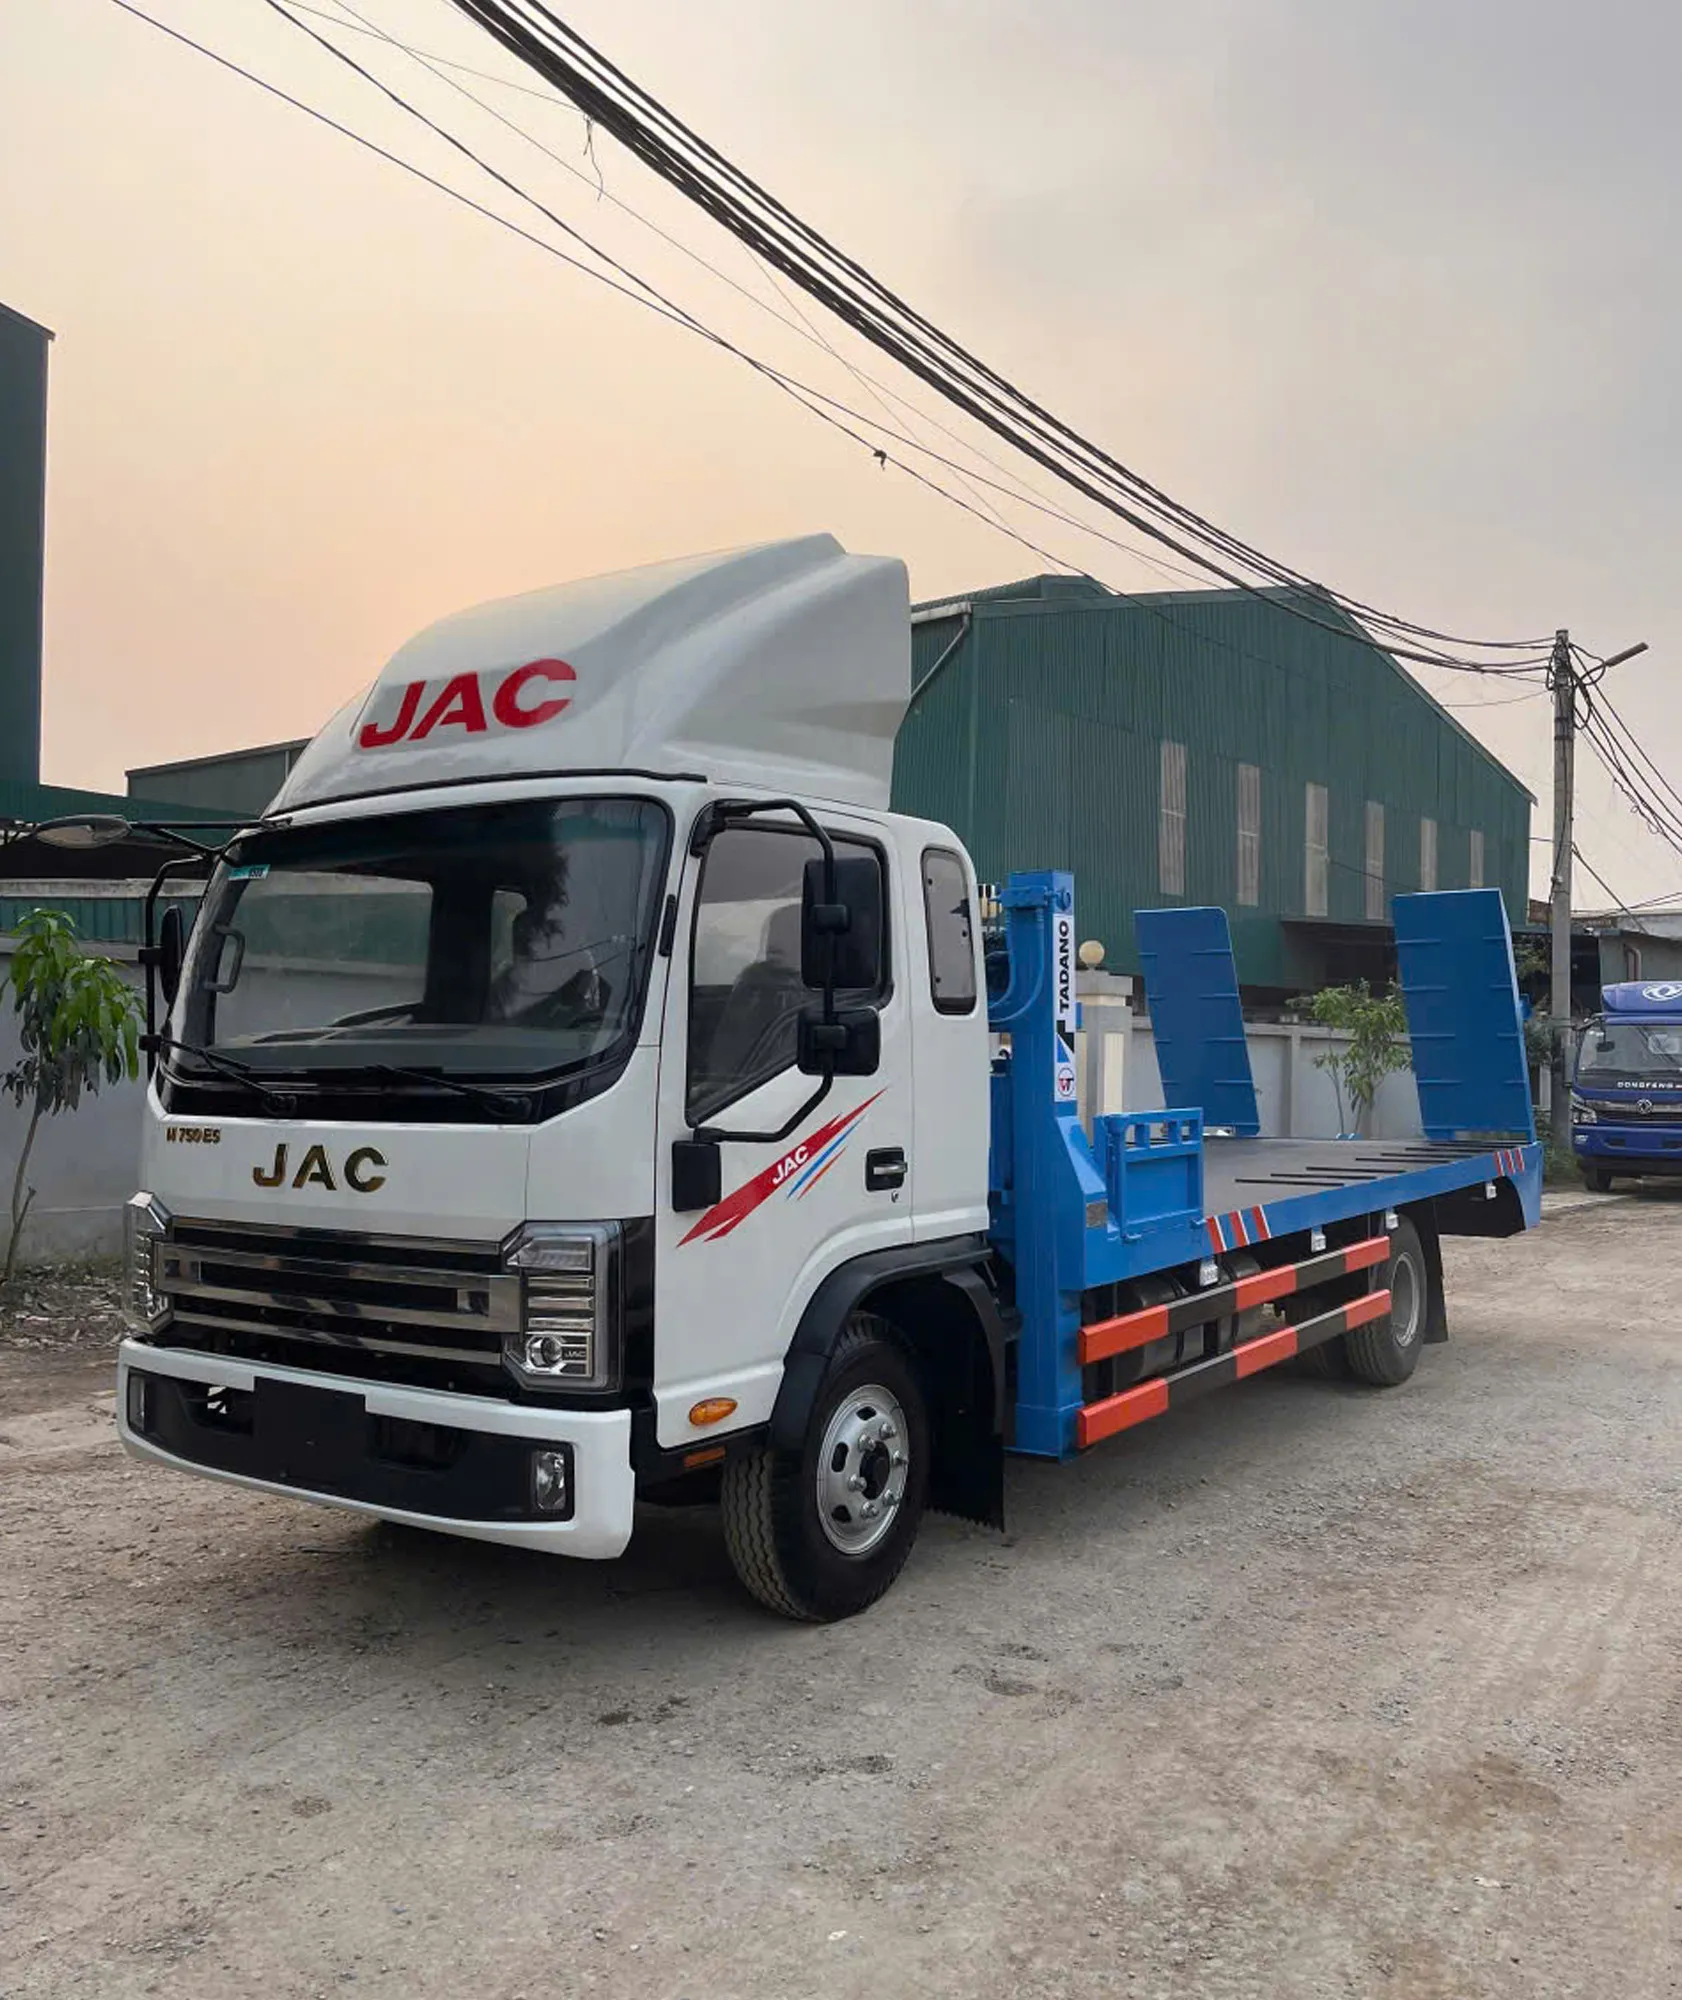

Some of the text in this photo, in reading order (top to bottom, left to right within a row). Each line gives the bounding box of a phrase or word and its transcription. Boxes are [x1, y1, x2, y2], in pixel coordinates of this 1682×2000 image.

[359, 658, 577, 748] JAC
[1059, 920, 1070, 1014] TADANO
[253, 1143, 388, 1193] JAC
[772, 1145, 809, 1185] JAC
